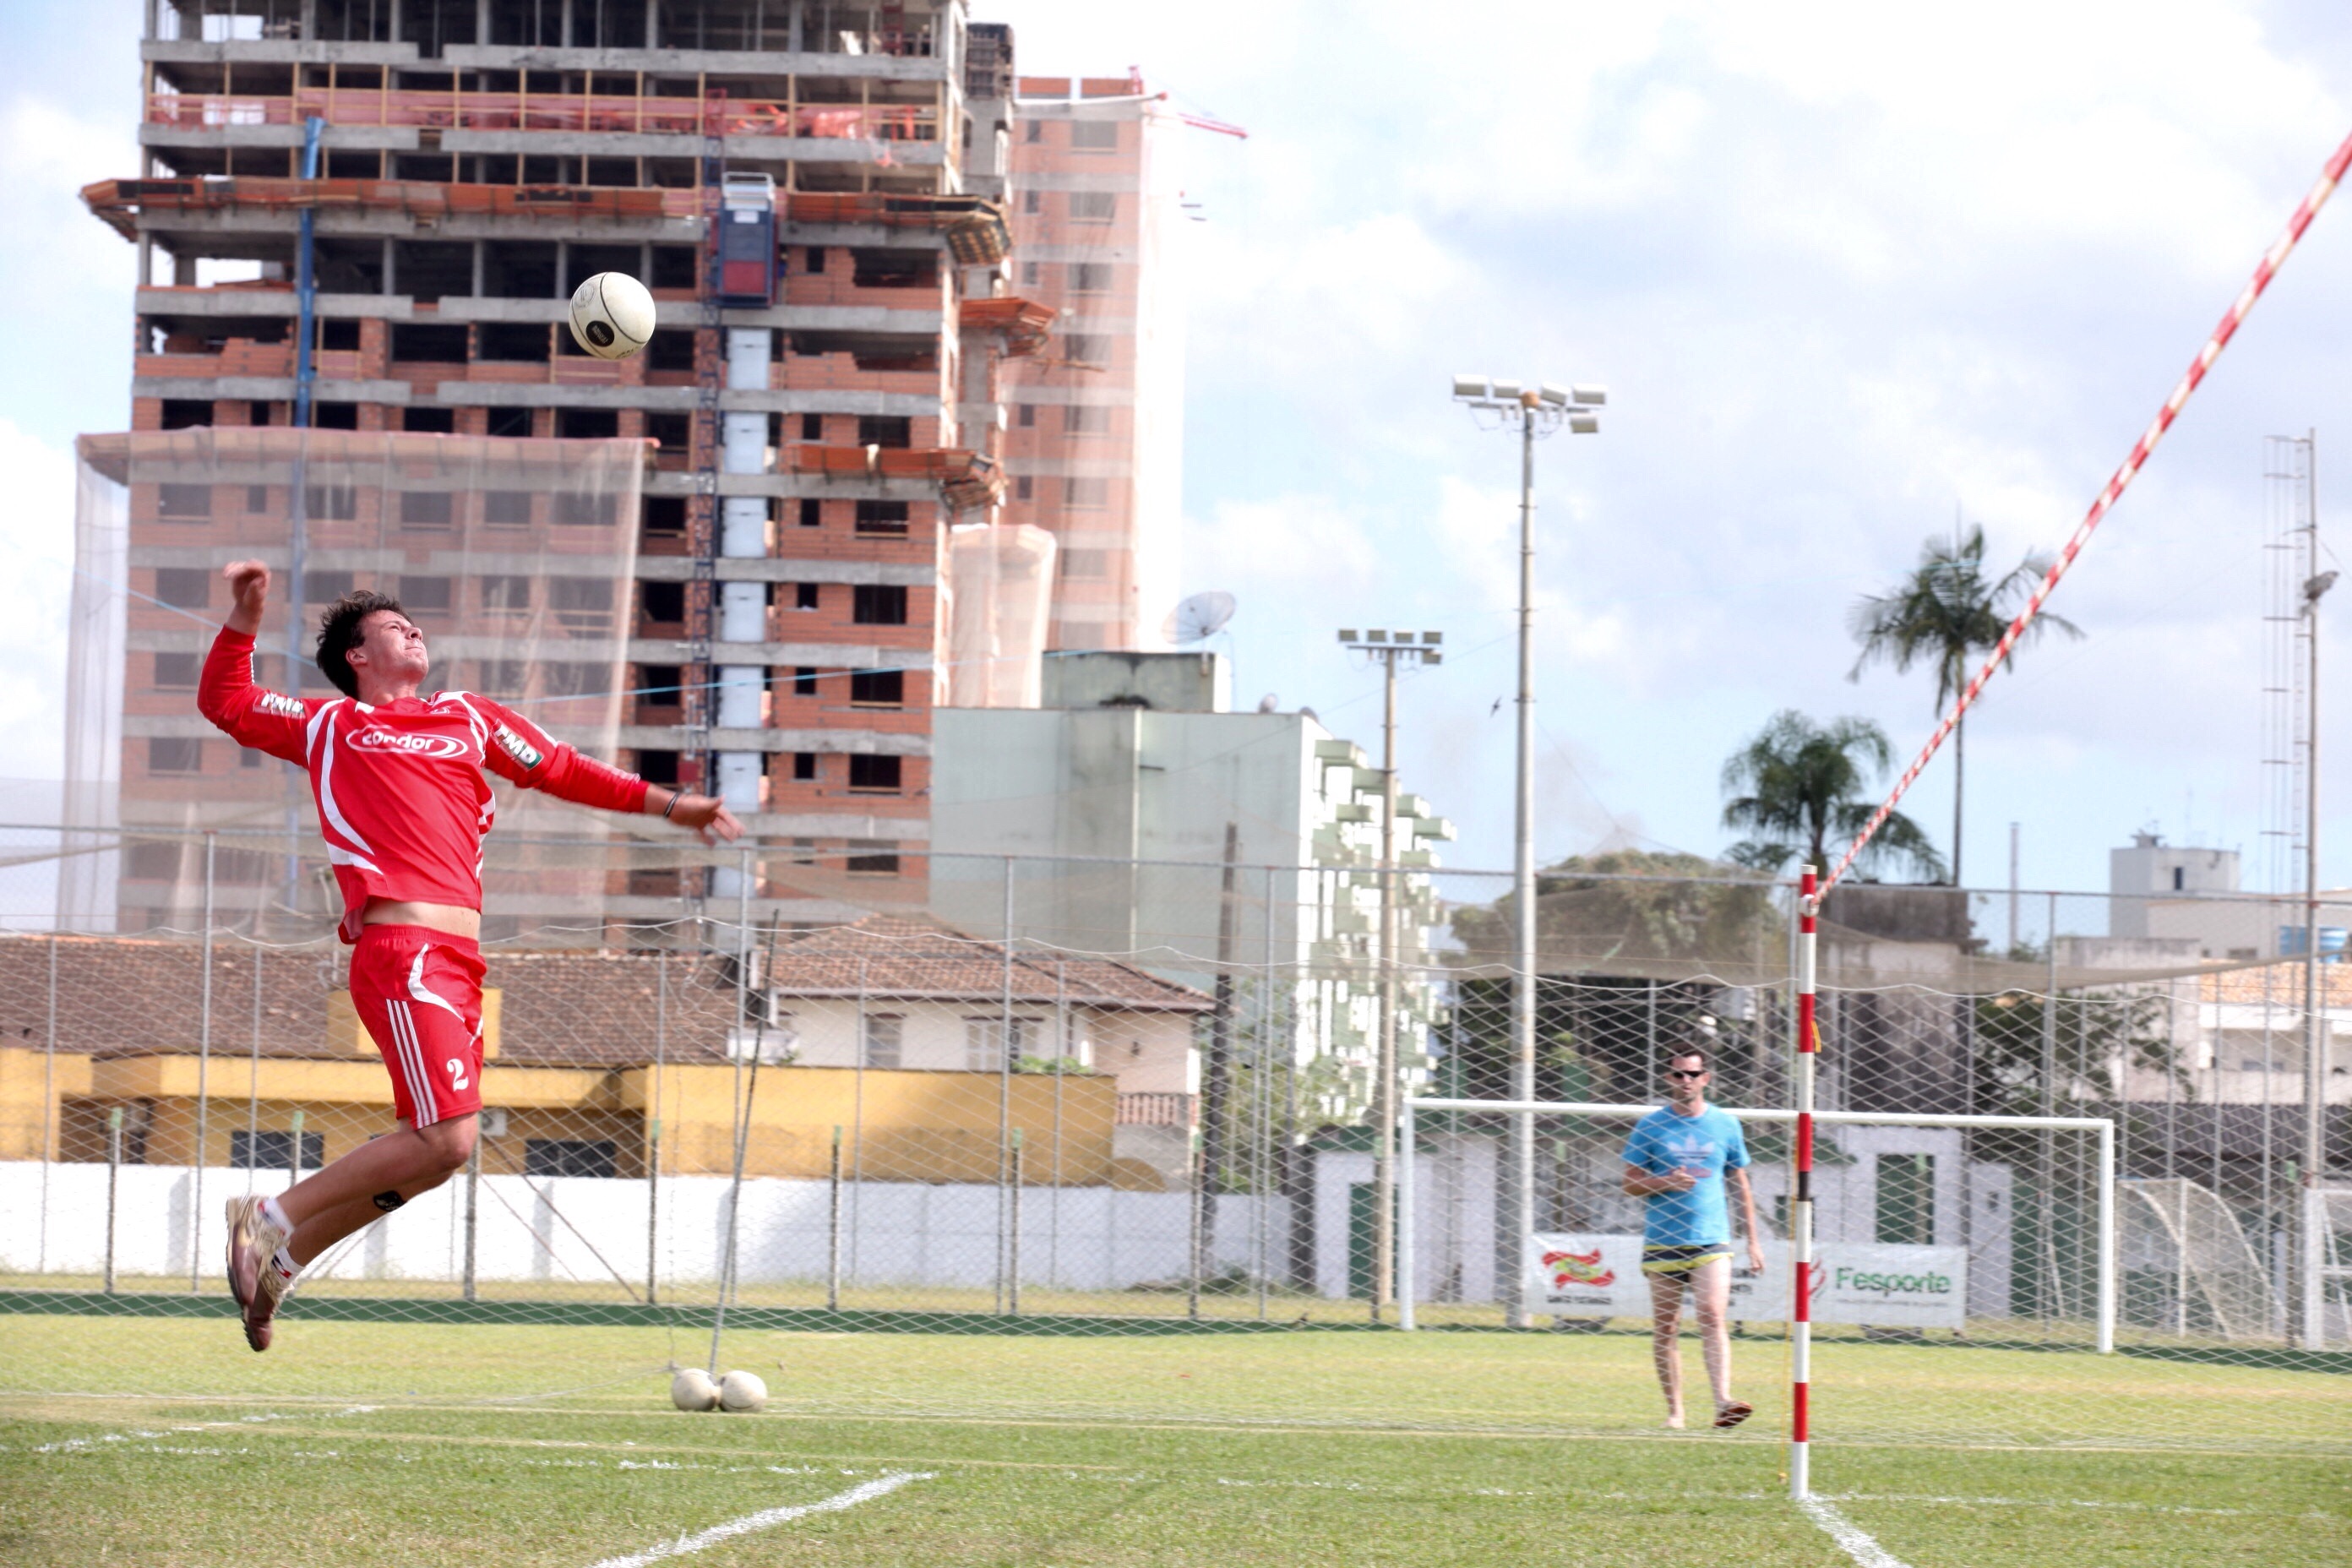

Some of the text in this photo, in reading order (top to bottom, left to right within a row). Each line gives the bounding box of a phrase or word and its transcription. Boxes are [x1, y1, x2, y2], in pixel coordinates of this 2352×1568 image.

[362, 730, 435, 750] condor
[494, 724, 537, 764] TMD
[446, 1058, 469, 1092] 2
[1836, 1266, 1952, 1297] Fesporte
